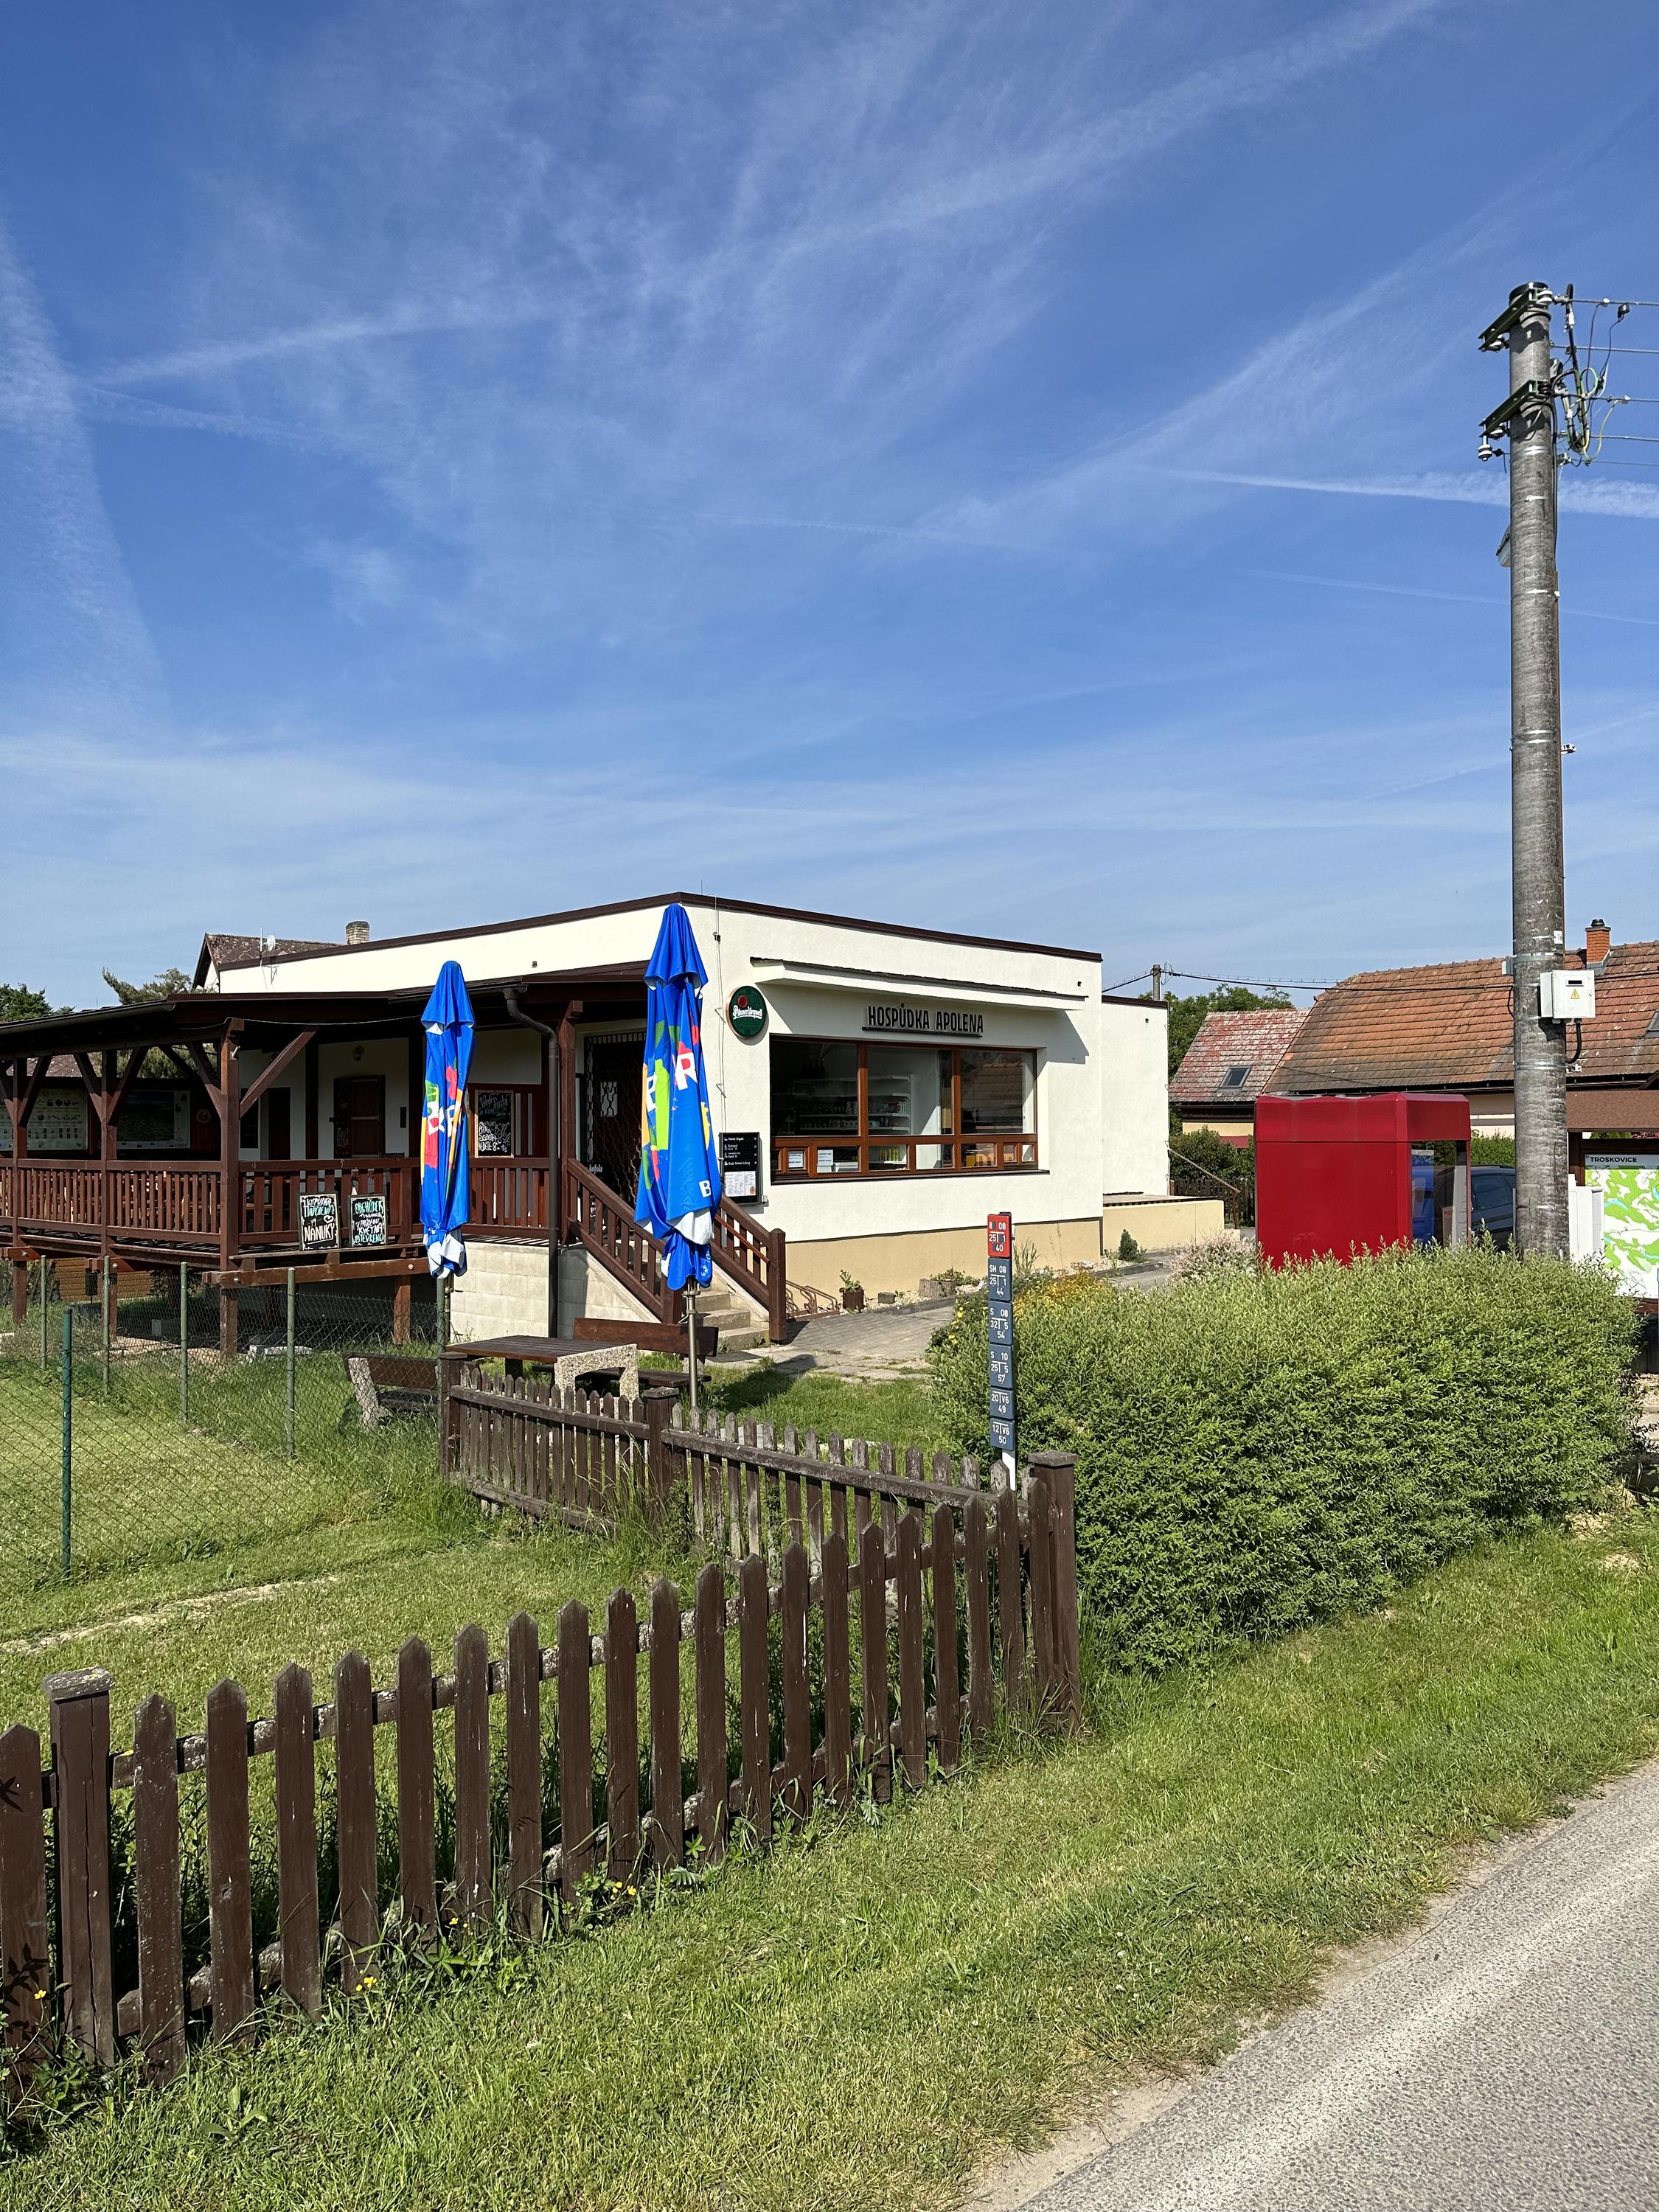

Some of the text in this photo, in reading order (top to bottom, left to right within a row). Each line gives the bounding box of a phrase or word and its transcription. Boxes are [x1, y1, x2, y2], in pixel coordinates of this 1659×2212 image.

[868, 1003, 984, 1033] HOSPŮDKA APOLENA
[998, 1222, 1006, 1231] 08
[304, 1222, 335, 1242] NANUKY
[995, 1244, 1004, 1253] 40
[989, 1264, 1006, 1274] SH 08
[990, 1307, 1009, 1318] S 08
[990, 1351, 1009, 1361] S 10
